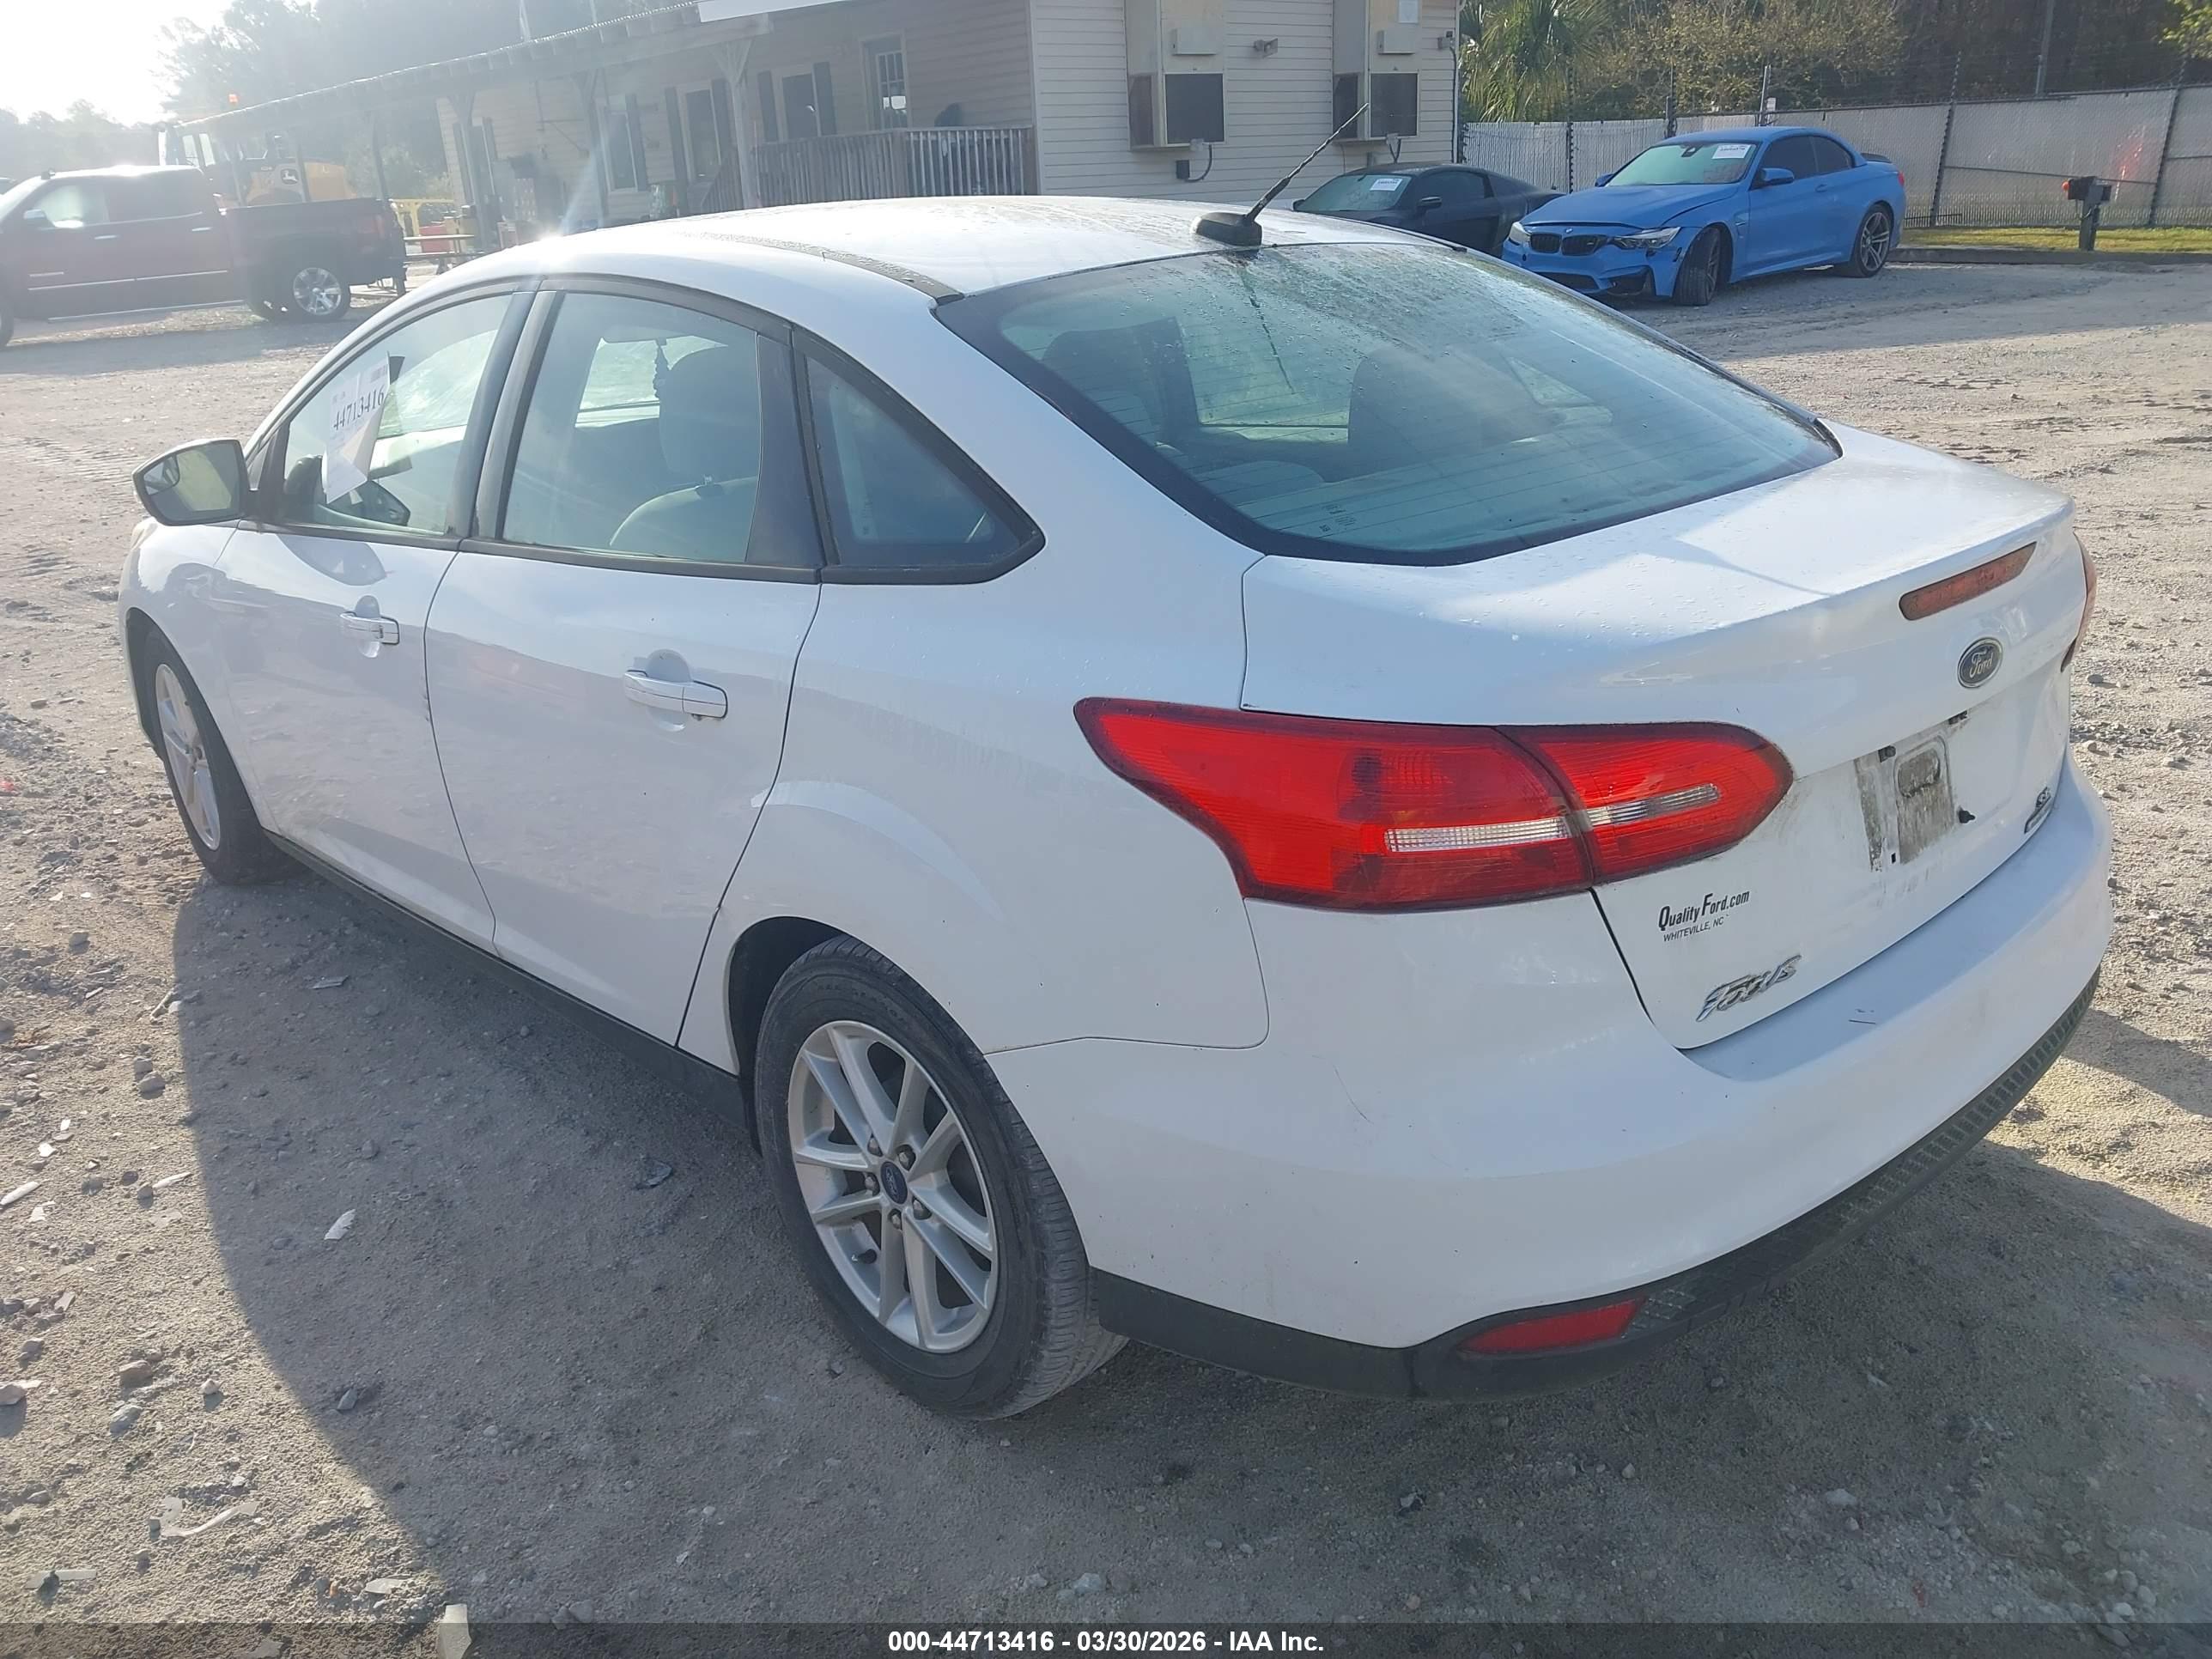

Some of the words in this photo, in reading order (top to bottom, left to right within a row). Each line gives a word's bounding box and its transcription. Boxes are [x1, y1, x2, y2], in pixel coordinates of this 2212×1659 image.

[333, 385, 385, 430] 44713416
[1663, 921, 1711, 942] WHITEVILLE,
[1713, 916, 1724, 928] NC
